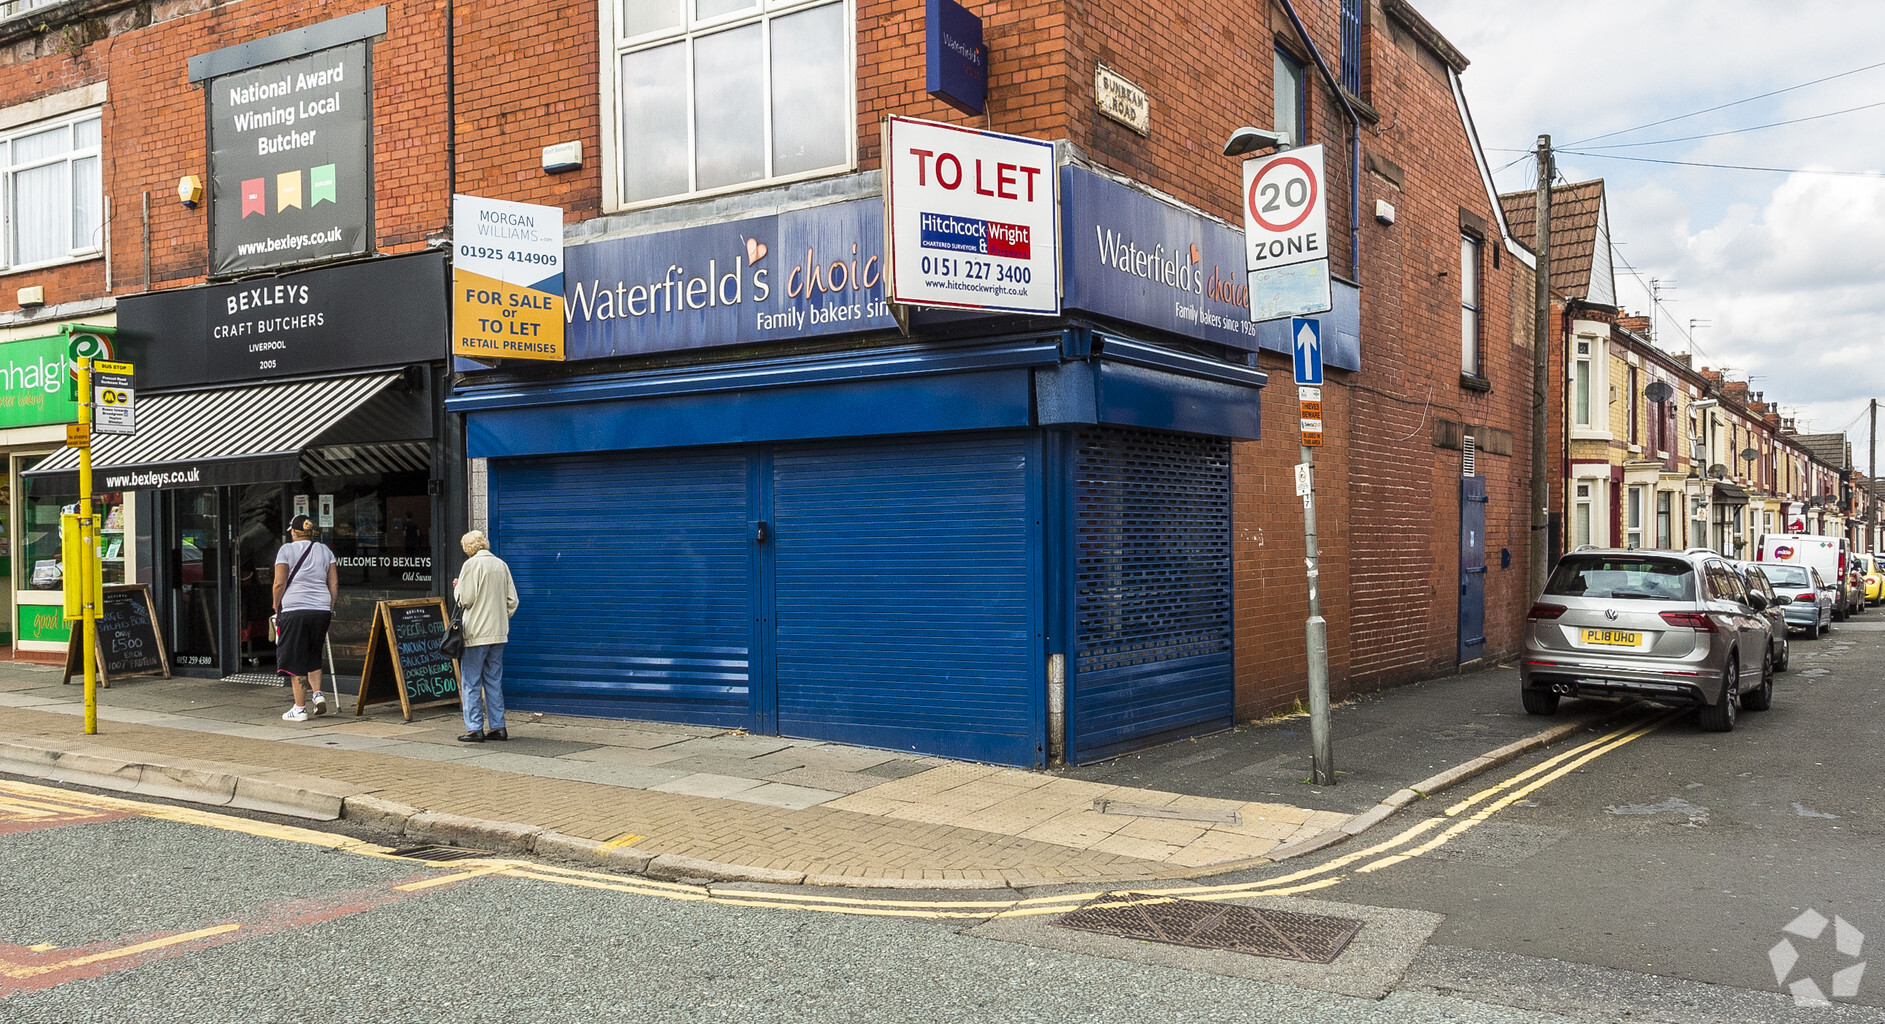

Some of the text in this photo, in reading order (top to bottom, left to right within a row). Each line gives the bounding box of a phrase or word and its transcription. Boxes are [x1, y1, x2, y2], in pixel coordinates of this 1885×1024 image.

[230, 62, 344, 106] National Award
[1103, 77, 1144, 109] SUNBEAM
[234, 92, 340, 132] Winning Local
[1112, 97, 1137, 122] ROAD
[258, 130, 317, 155] Butcher
[910, 148, 1041, 202] TO LET
[1260, 177, 1308, 213] 20
[480, 210, 534, 227] MORGAN
[922, 214, 1029, 245] Hitchcock Wright
[238, 226, 342, 255] www.bexleys.co.uk
[922, 240, 977, 251] CHARTERED SURVEYORS
[980, 239, 1027, 258] & Partners
[1255, 233, 1318, 260] ZONE
[460, 245, 557, 266] 01925 414909
[787, 243, 887, 299] choic
[921, 256, 1031, 284] 0151 227 3400
[925, 280, 1029, 296] www.hitchcockwright.co.uk
[1207, 265, 1249, 309] choice
[227, 285, 309, 315] BEXLEYS
[466, 289, 552, 310] FOR SALE
[502, 309, 517, 318] or
[757, 298, 889, 330] Family bakers sin
[1175, 302, 1257, 337] Family bakers since 1926
[214, 313, 325, 338] CRAFT BUTCHERS
[478, 319, 541, 336] TO LET
[249, 340, 287, 352] LIVERPOOL
[462, 337, 556, 353] RETAIL PREMISES
[260, 359, 277, 370] 2005
[1301, 402, 1320, 411] THIEVES
[1302, 411, 1320, 419] BEWARE
[106, 467, 200, 488] www.bexleys.co.uk
[335, 557, 431, 567] WELCOME TO BEXLEYS
[402, 572, 415, 581] Old
[33, 609, 57, 637] good
[396, 623, 427, 638] SPECIAL
[1587, 630, 1635, 643] PL18 UHO
[406, 681, 416, 698] 5
[417, 678, 432, 695] FOR
